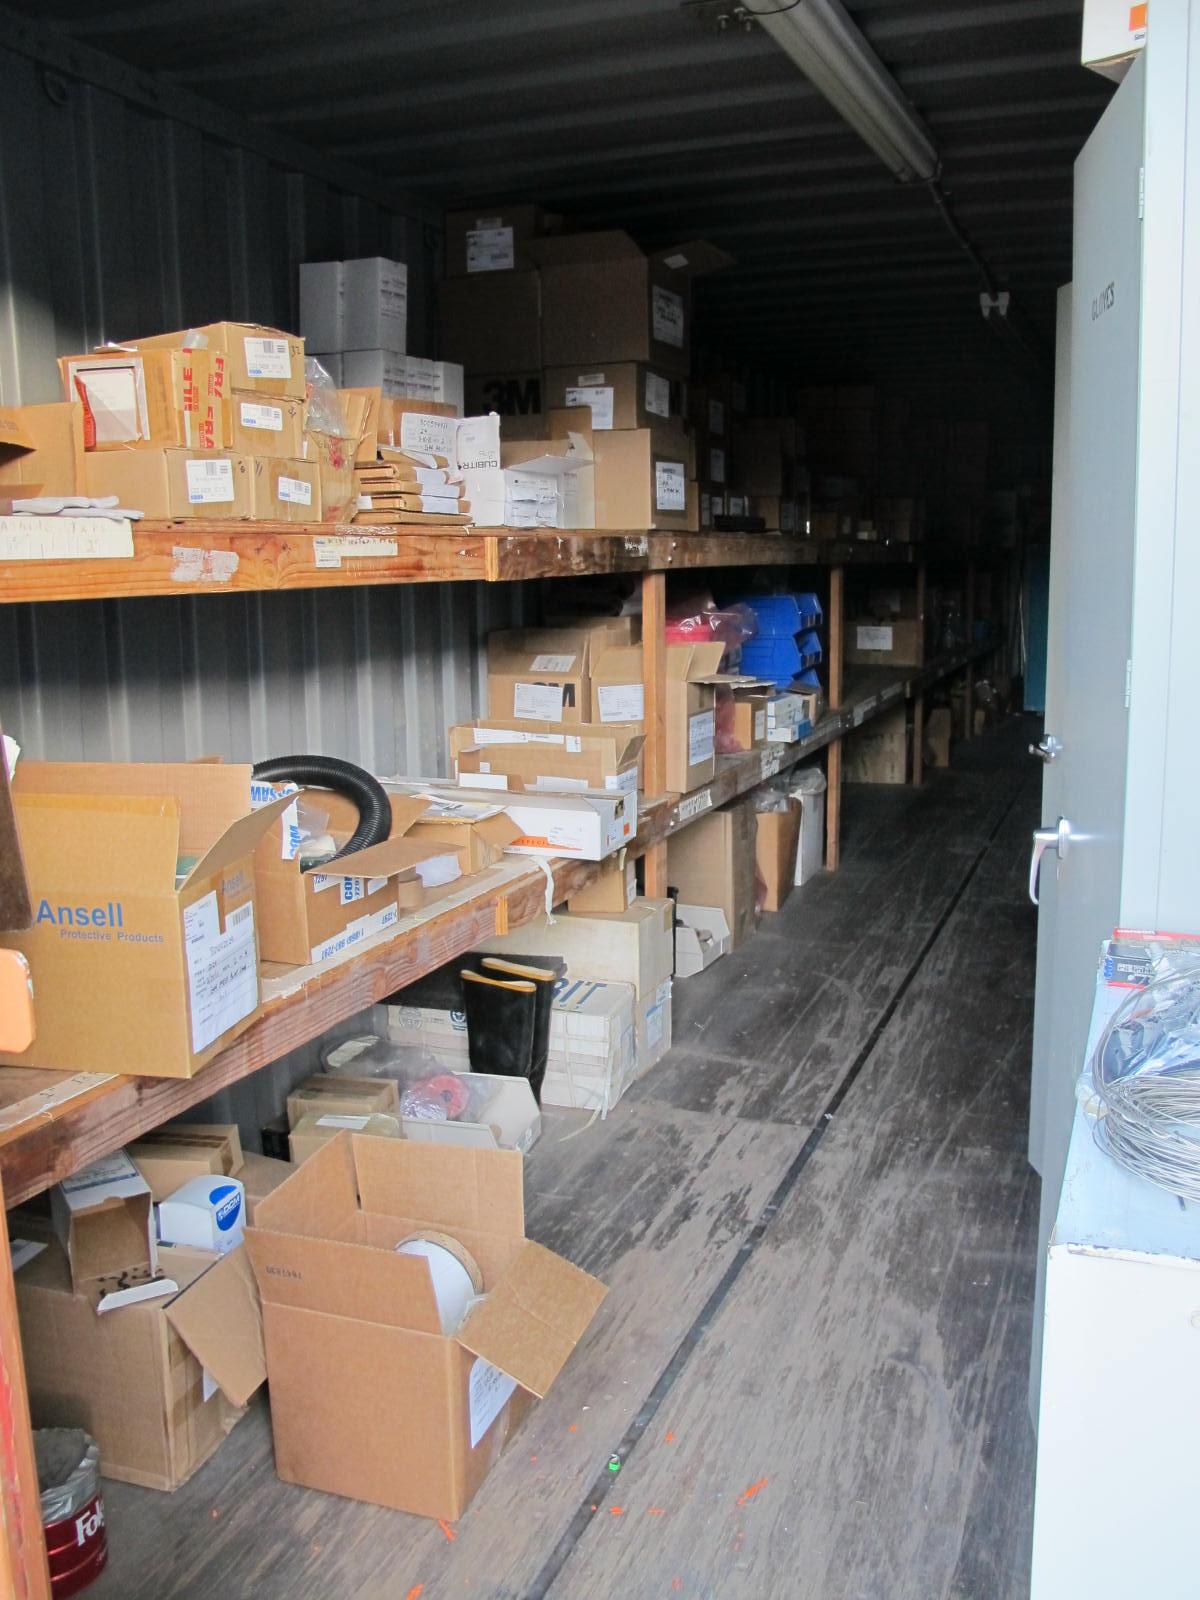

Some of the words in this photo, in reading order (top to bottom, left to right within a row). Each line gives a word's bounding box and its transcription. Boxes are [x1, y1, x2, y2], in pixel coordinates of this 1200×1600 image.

[482, 379, 542, 416] 3M
[35, 899, 124, 928] Ansell
[60, 928, 112, 941] Protective
[117, 931, 164, 943] Products
